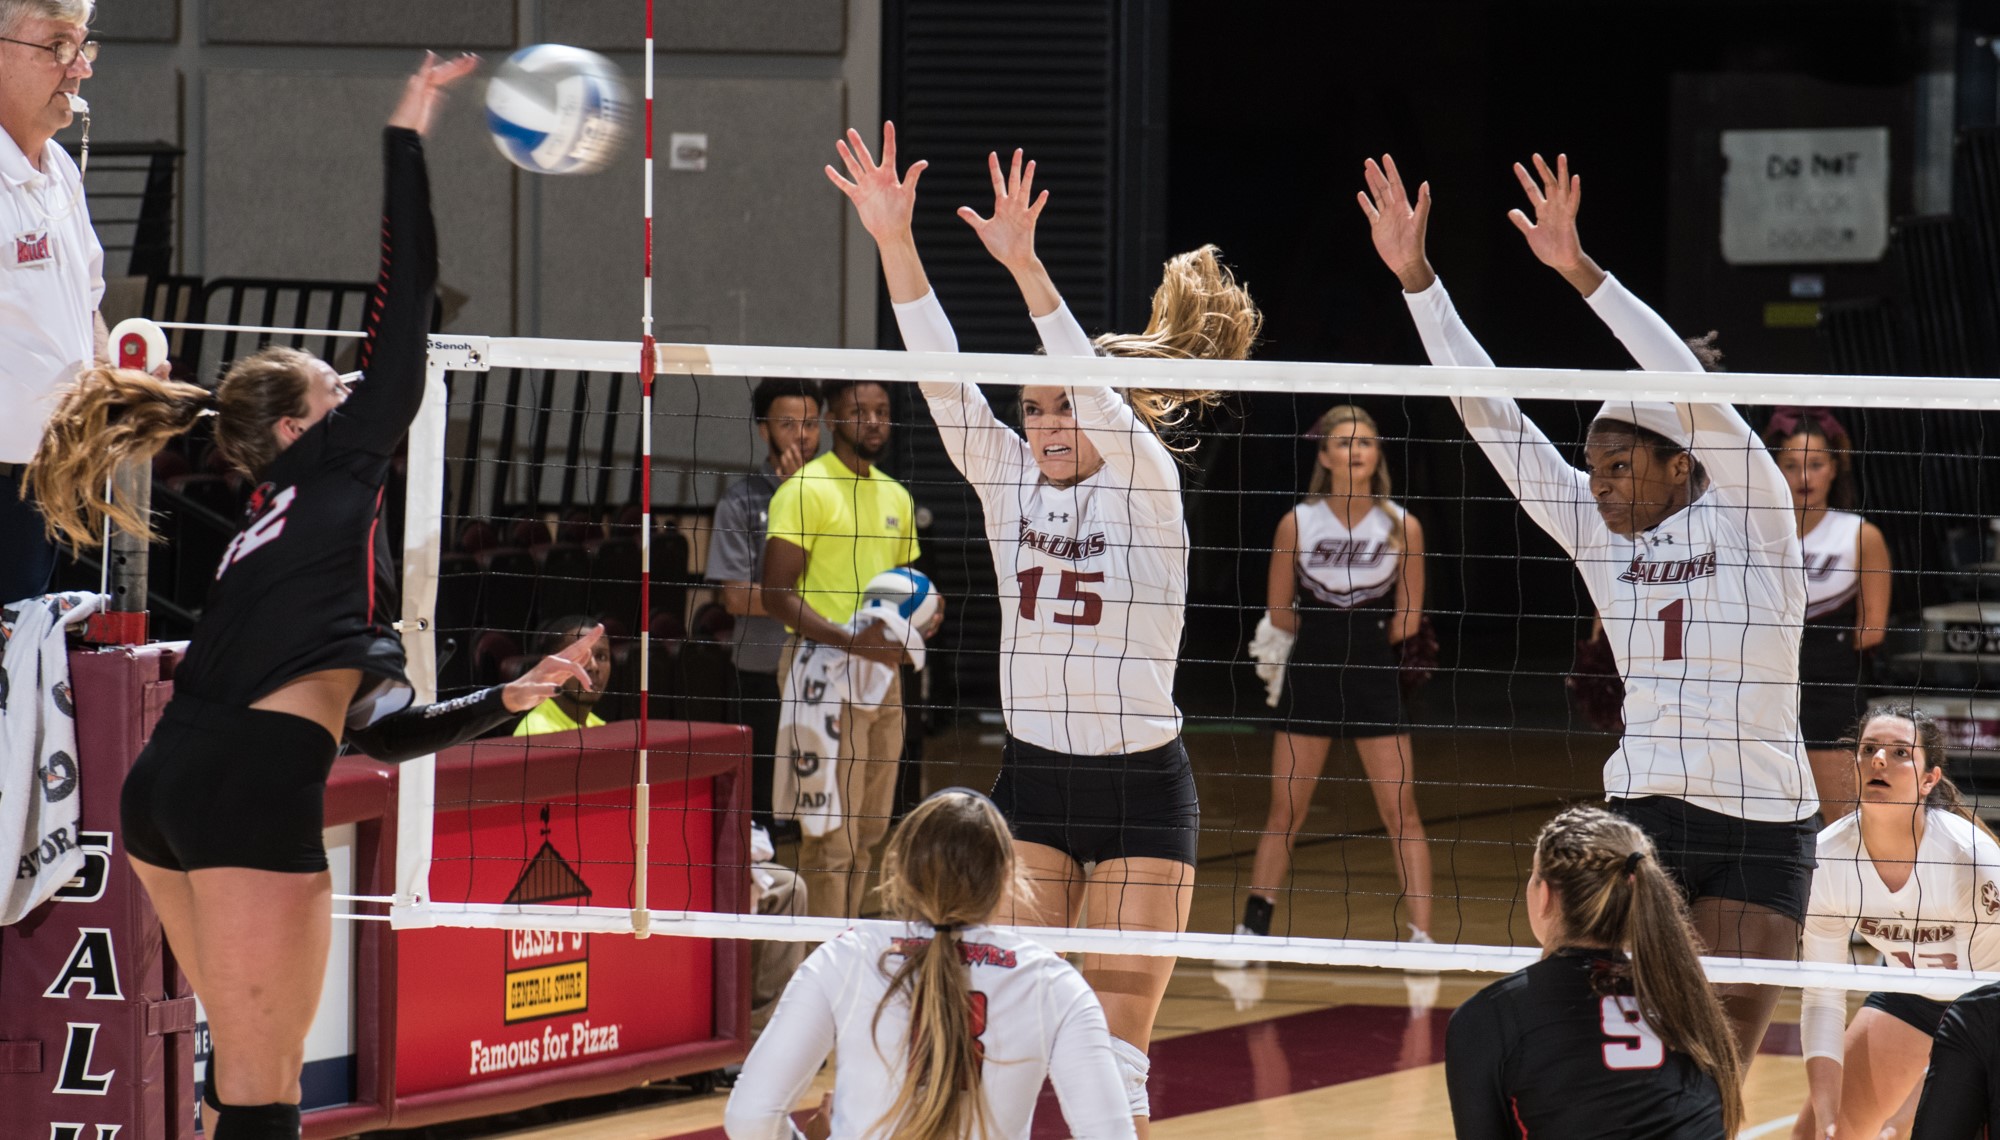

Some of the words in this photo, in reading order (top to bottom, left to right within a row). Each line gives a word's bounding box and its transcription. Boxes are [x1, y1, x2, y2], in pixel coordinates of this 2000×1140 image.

[1767, 154, 1802, 180] DO
[1811, 152, 1860, 177] NOT
[435, 341, 472, 350] Senoh
[1617, 551, 1716, 585] SALUKIS
[1017, 566, 1104, 626] 15
[1658, 598, 1684, 661] 1
[16, 818, 81, 881] ATOR
[511, 929, 583, 960] CASES
[42, 831, 126, 1140] SAL
[511, 977, 551, 1009] GENERAL
[555, 971, 582, 1002] STORE
[469, 1039, 540, 1075] Famous
[542, 1025, 569, 1062] for
[572, 1019, 619, 1057] Pizza
